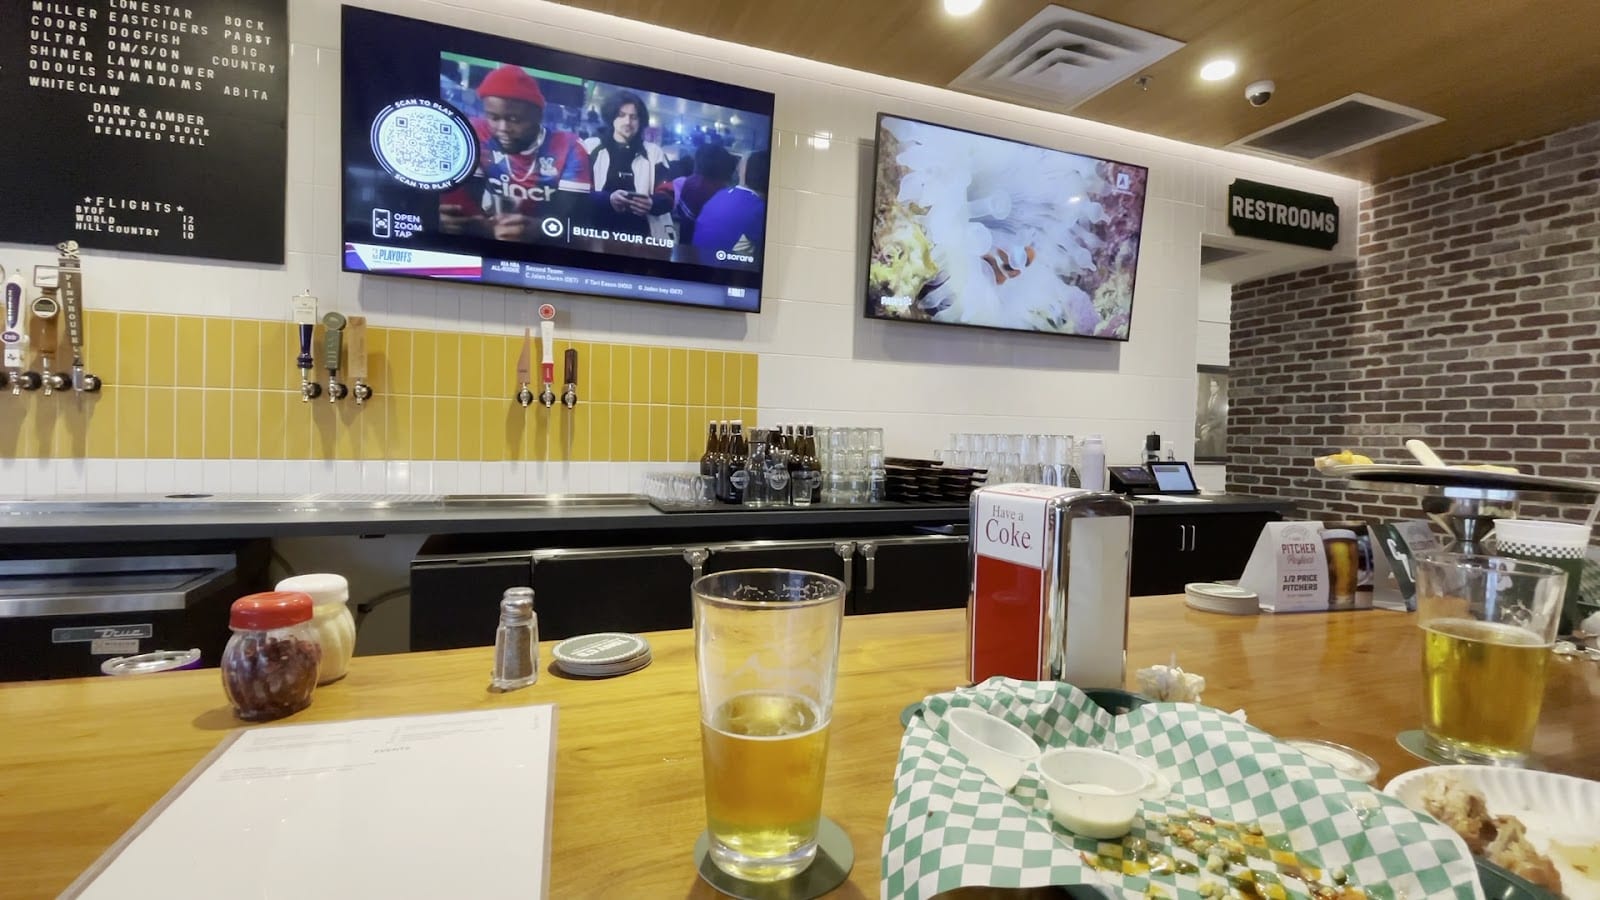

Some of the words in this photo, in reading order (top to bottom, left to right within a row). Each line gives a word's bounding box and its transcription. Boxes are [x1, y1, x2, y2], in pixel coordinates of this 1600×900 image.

[32, 1, 97, 19] MILLER
[109, 0, 192, 19] LONESTAR
[31, 16, 88, 32] COORS
[109, 12, 208, 36] EASTCIDERS
[224, 15, 264, 31] BOCK
[30, 30, 86, 47] ULTRA
[108, 26, 180, 46] DOGFISH
[30, 45, 93, 62] SHINER
[231, 44, 257, 58] BIG
[29, 59, 96, 77] ODOULS
[107, 55, 215, 79] LAWNMOWER
[212, 55, 275, 74] COUNTRY
[29, 76, 75, 91] WHITE
[79, 83, 120, 97] CLAW
[107, 69, 140, 83] SAM
[146, 74, 203, 91] ADAMS
[223, 85, 268, 101] ABITA
[93, 102, 130, 116] DARK
[138, 108, 147, 118] &
[155, 110, 205, 126] AMBER
[394, 98, 417, 109] SCAN
[419, 98, 431, 107] TO
[432, 102, 454, 117] PLAY
[87, 114, 166, 131] CRAWFORD
[174, 124, 210, 137] BOCK
[95, 125, 161, 141] BEARDED
[169, 134, 205, 147] SEAL
[394, 173, 417, 188] SCAN
[419, 182, 430, 191] TO
[431, 181, 452, 191] PLAY
[96, 196, 171, 214] FLIGHTS
[1232, 195, 1335, 233] RESTROOMS
[75, 205, 105, 216] BYOF
[182, 215, 194, 224] 12
[75, 213, 115, 225] WORLD
[182, 223, 194, 232] 10
[393, 212, 421, 224] OPEN
[75, 221, 102, 232] HILL
[108, 224, 160, 237] COUNTRY
[182, 231, 194, 240] 10
[393, 222, 424, 232] ZOOM
[393, 229, 413, 239] TAP
[572, 225, 610, 240] BUILD
[612, 231, 644, 245] YOUR
[645, 235, 675, 250] CLUB
[379, 248, 413, 264] PLAYOFFS
[726, 252, 754, 264] sorare
[992, 504, 1016, 521] Have
[1018, 513, 1024, 521] a
[985, 518, 1031, 549] Coke
[1281, 543, 1317, 554] PITCHER
[1297, 574, 1318, 582] PRICE
[1282, 583, 1318, 592] PITCHERS
